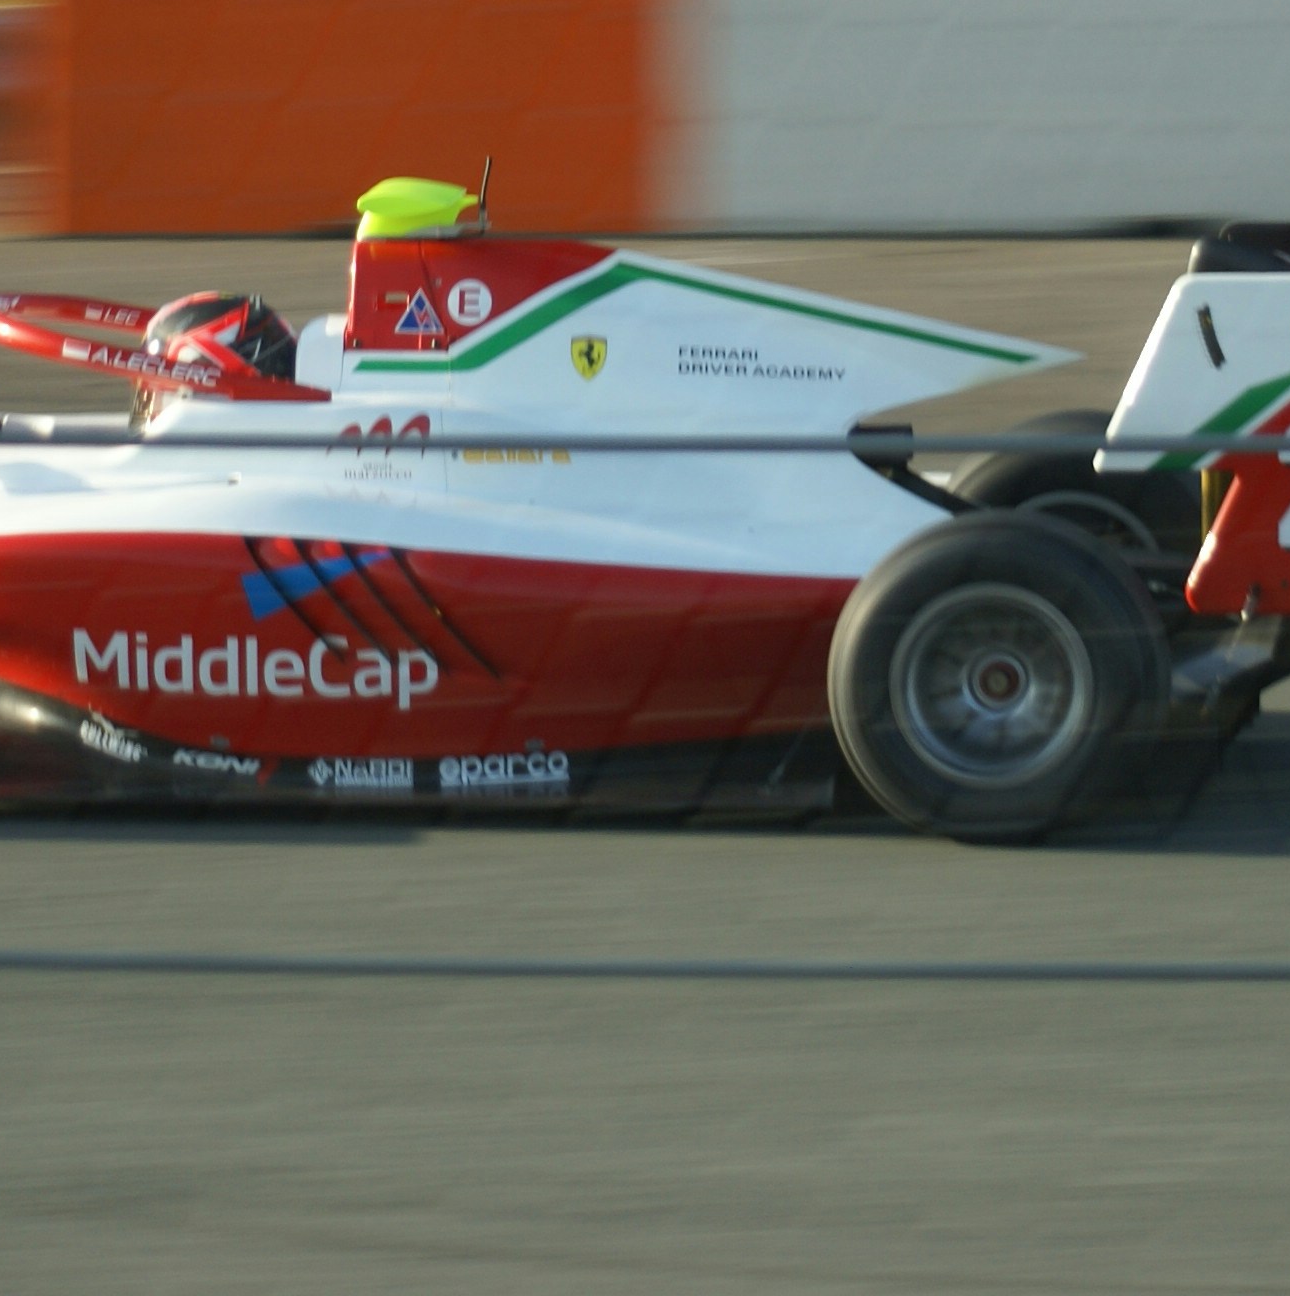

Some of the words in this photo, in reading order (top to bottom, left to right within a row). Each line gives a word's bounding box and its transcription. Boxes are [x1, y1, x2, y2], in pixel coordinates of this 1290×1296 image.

[458, 285, 482, 318] E
[91, 346, 222, 388] A.LECLERC
[677, 345, 760, 362] FERRARI
[677, 361, 748, 377] DRIVER
[752, 364, 846, 381] ACADEMY
[72, 627, 440, 711] MiddleCap
